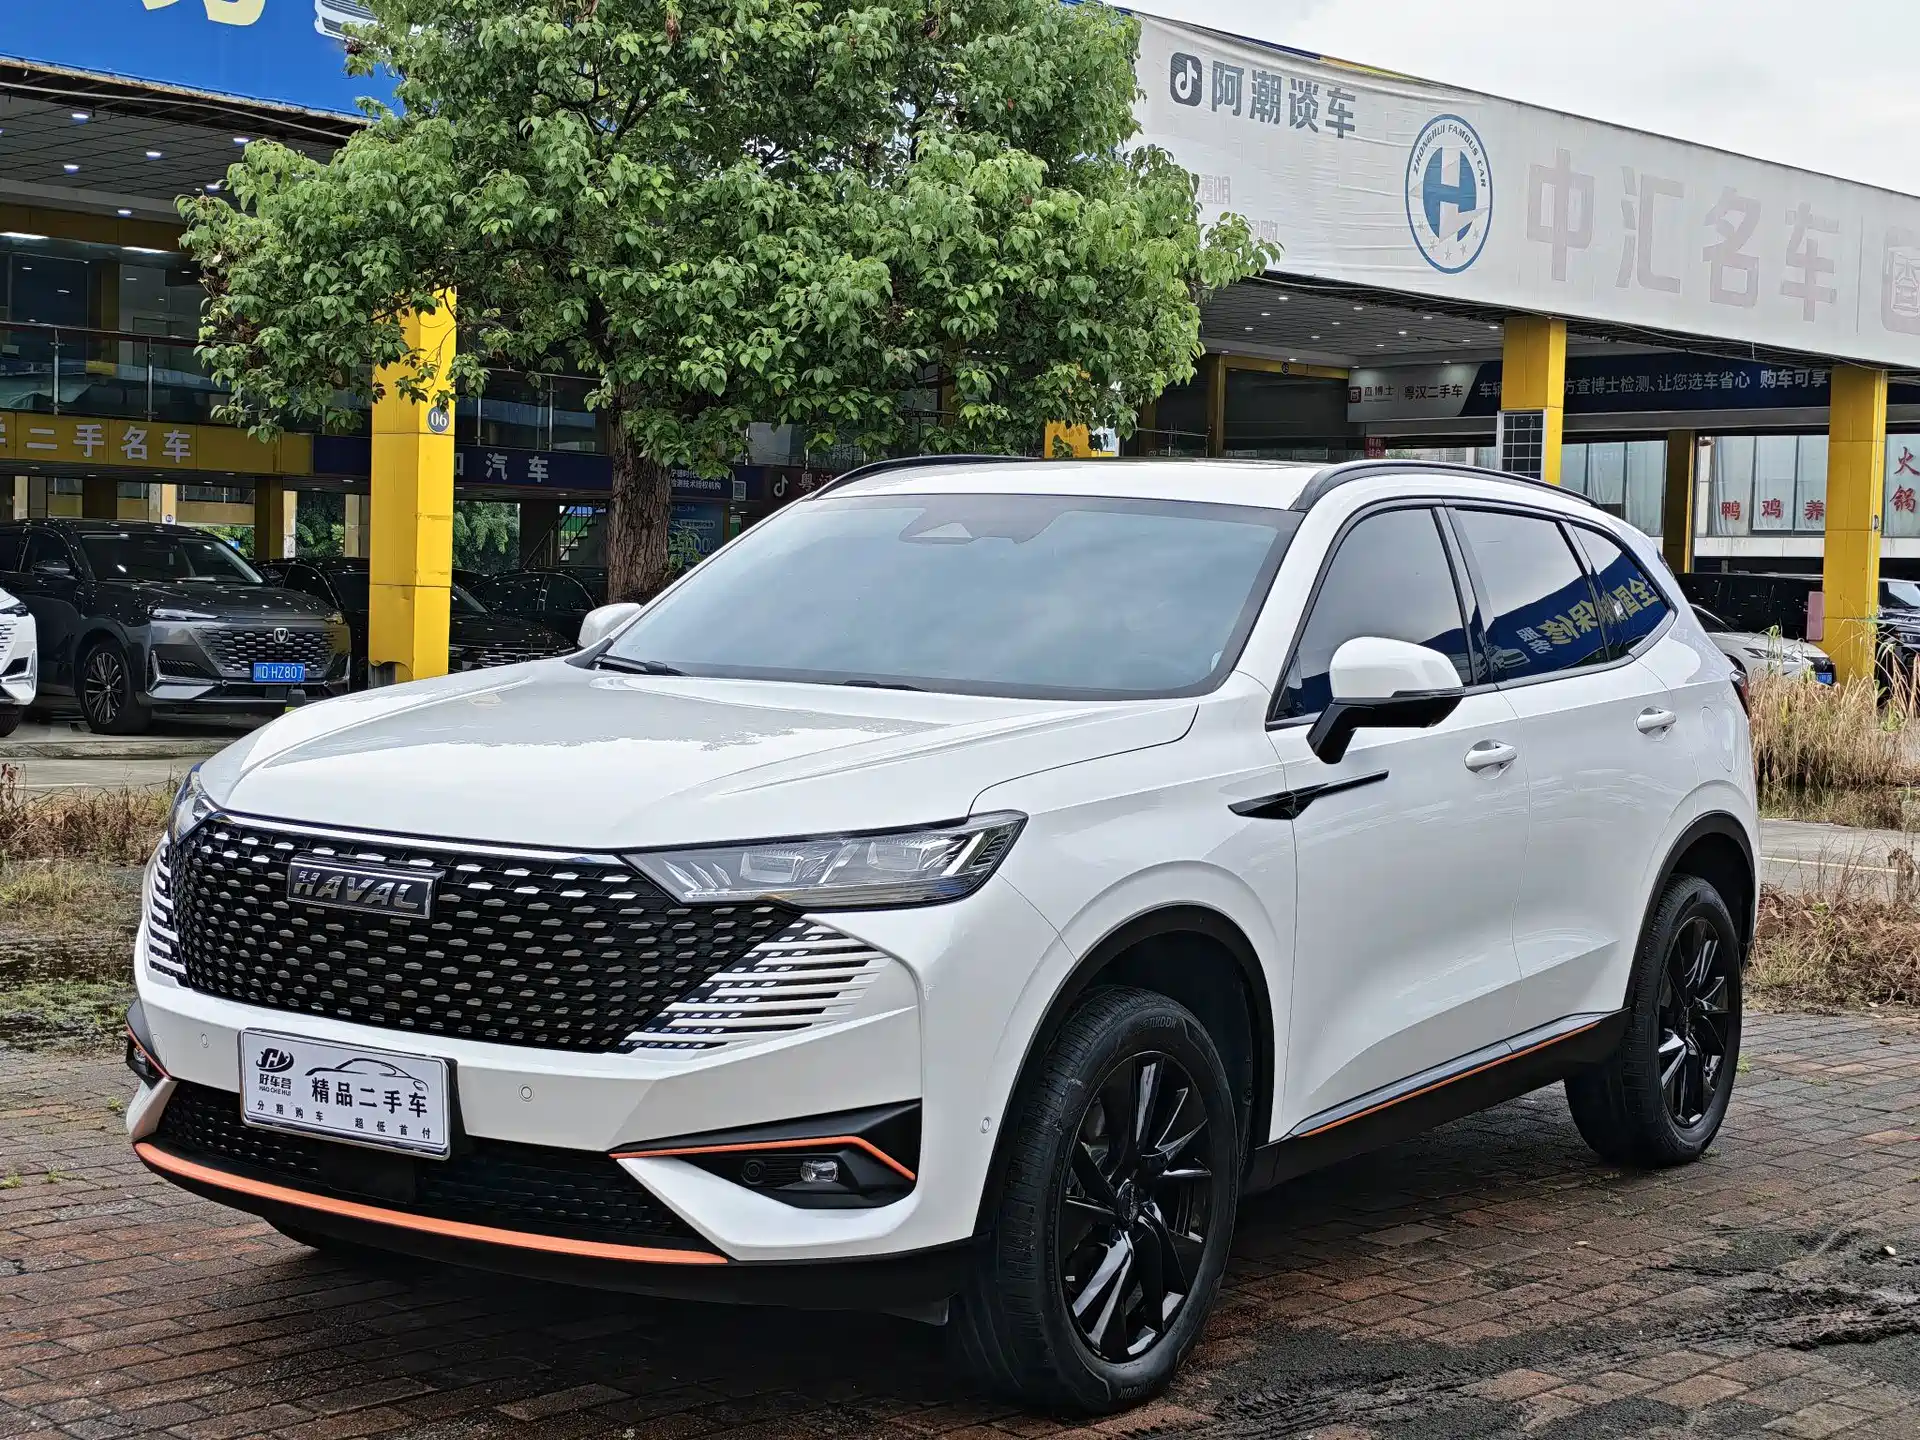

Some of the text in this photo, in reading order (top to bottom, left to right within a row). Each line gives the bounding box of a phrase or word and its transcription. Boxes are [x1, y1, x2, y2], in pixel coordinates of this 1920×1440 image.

[1212, 60, 1356, 139] 阿潮谈车
[1413, 124, 1446, 176] ZHONGHUI
[1448, 124, 1479, 156] FAMOUS
[1526, 148, 1840, 323] 中汇名车
[1403, 383, 1463, 400] 粤汉二手车
[1760, 369, 1828, 389] 购车可享
[430, 410, 448, 428] 06
[0, 416, 191, 464] 二手名车
[292, 870, 419, 910] HAVAL
[311, 1077, 427, 1118] 精品二手车
